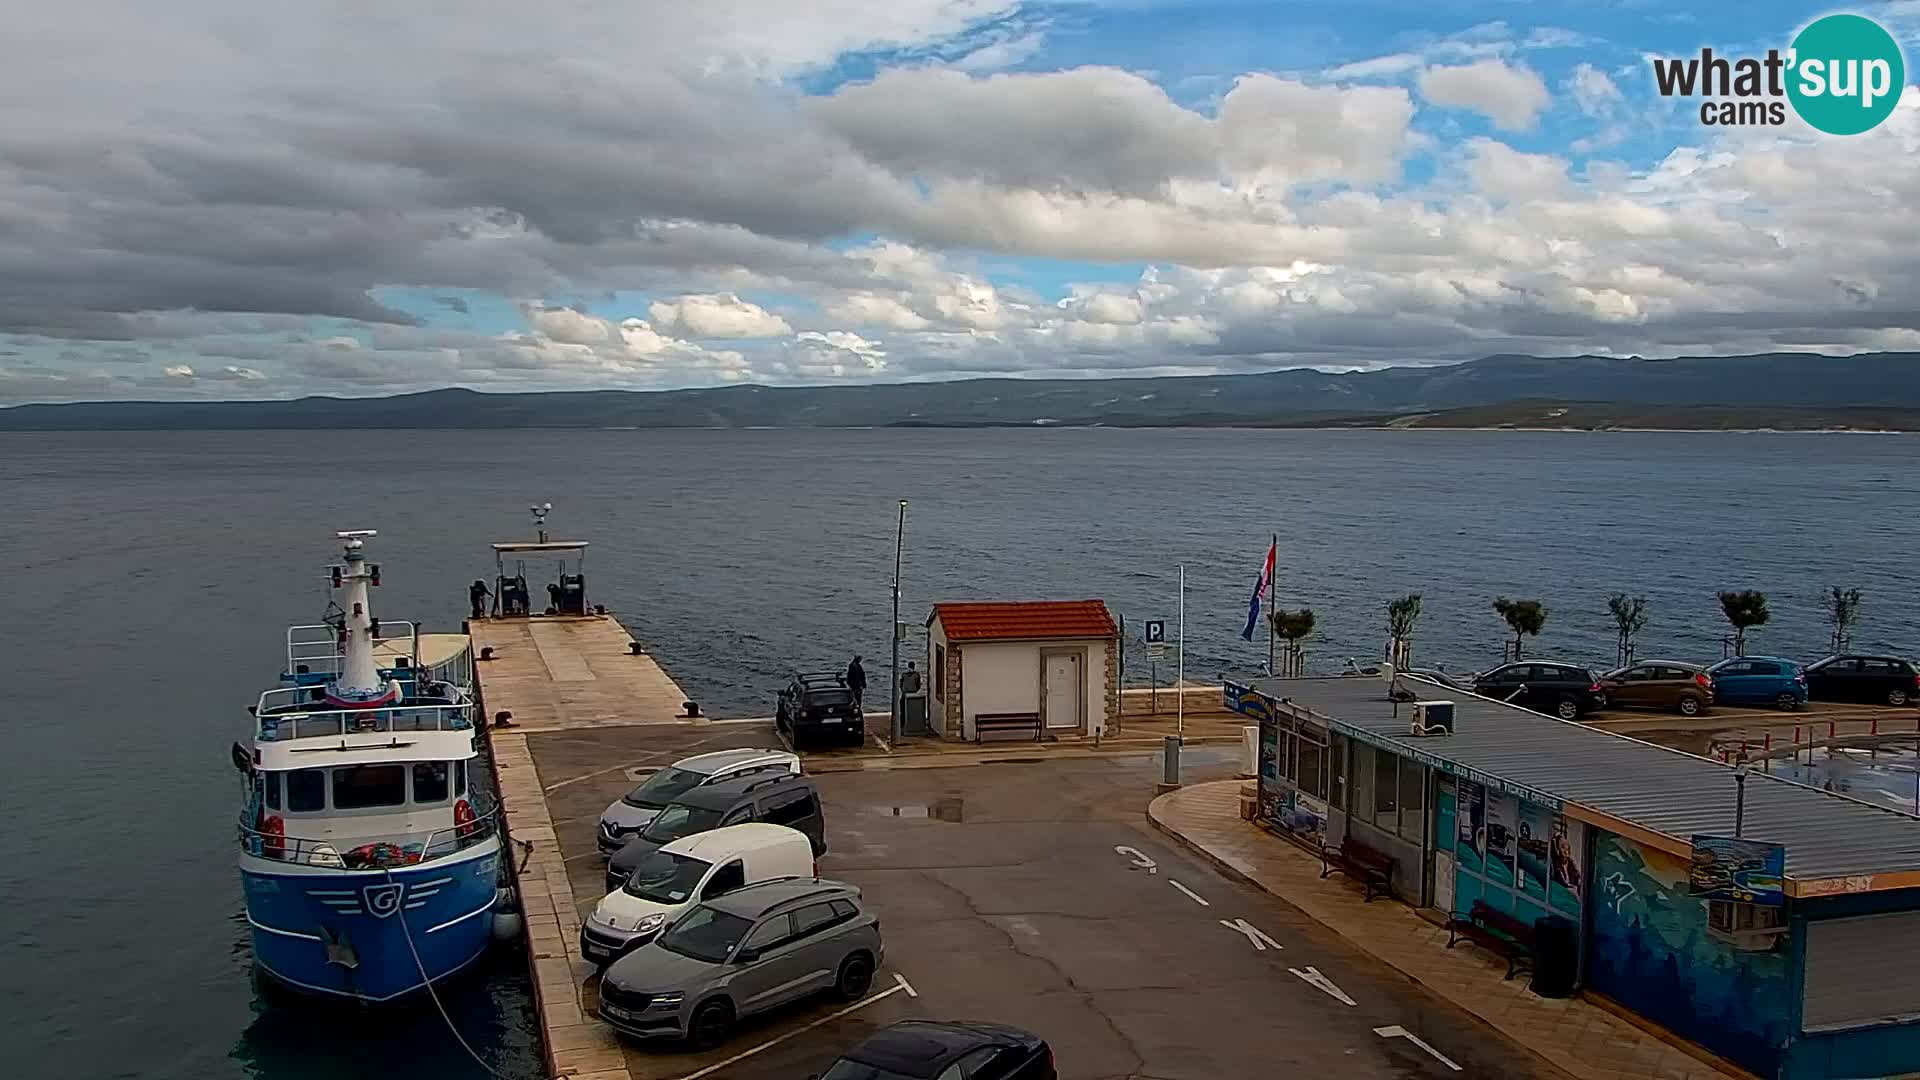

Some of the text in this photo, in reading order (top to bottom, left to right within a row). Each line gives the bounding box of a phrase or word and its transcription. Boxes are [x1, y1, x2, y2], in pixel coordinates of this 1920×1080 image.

[1150, 623, 1160, 640] P
[1453, 765, 1469, 778] BUS
[1469, 771, 1501, 788] STATION
[1504, 782, 1529, 799] TICKET
[1531, 793, 1558, 809] OFFICE
